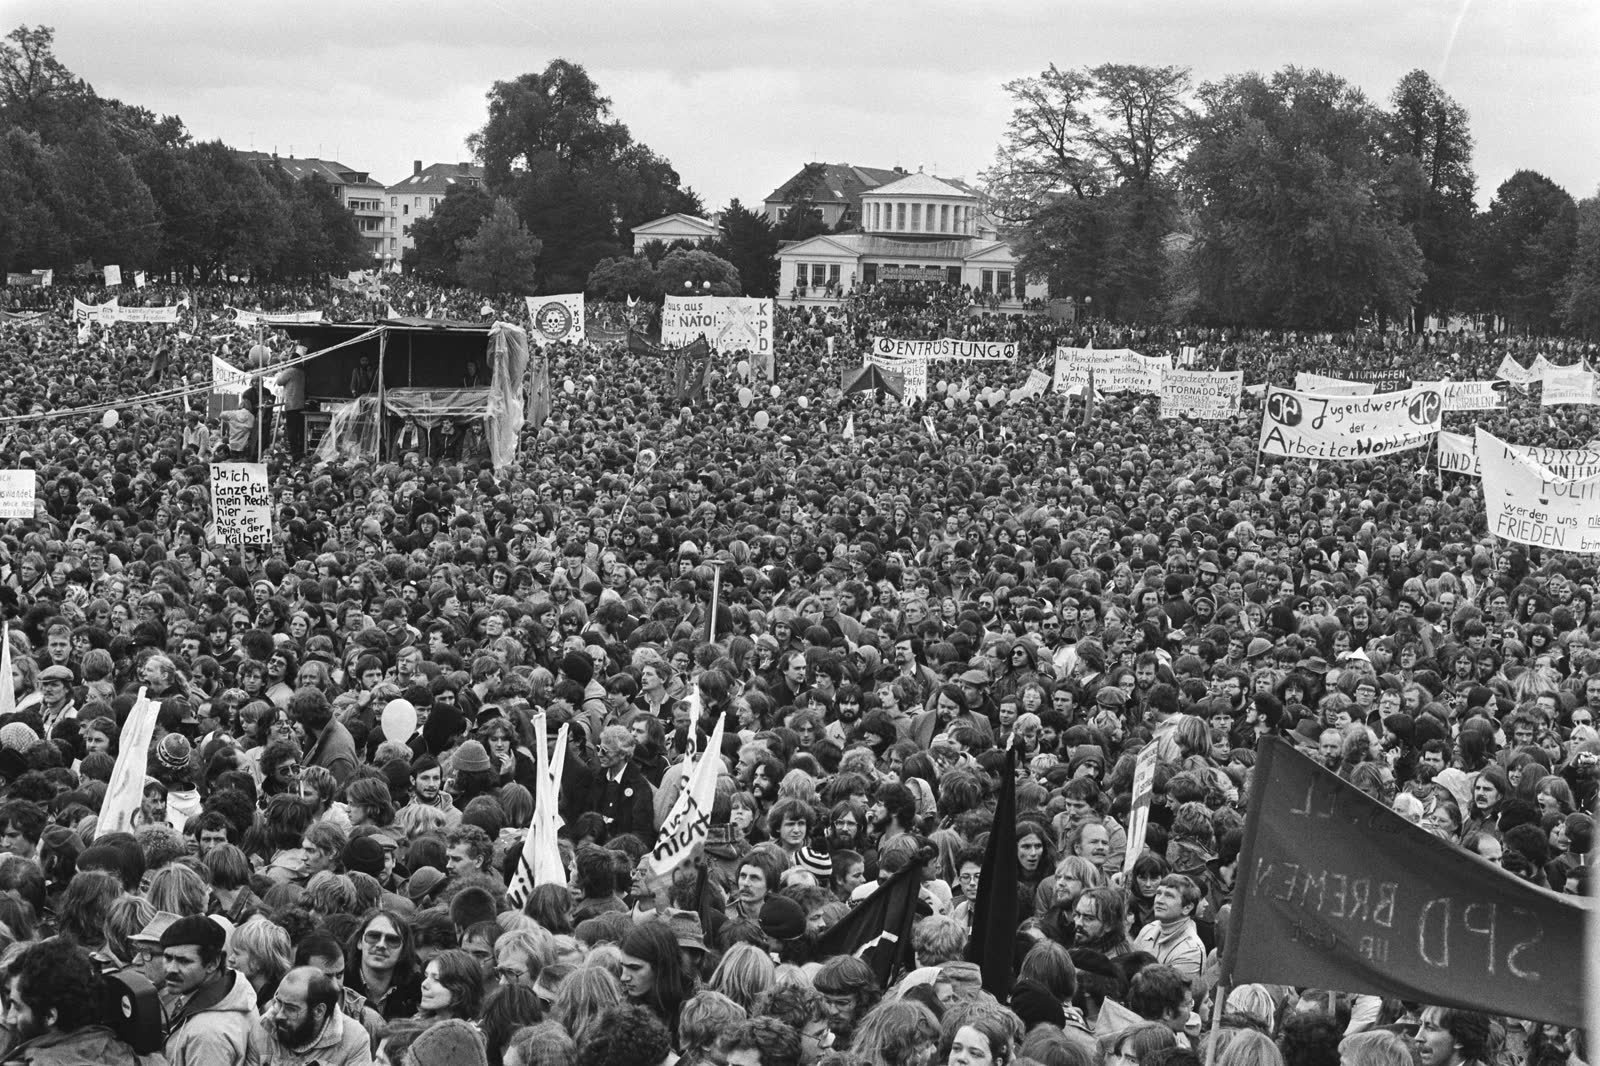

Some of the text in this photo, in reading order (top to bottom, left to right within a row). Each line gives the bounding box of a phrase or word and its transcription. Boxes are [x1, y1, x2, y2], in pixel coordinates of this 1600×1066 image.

[684, 302, 703, 312] aus
[679, 314, 717, 328] NATO!
[896, 337, 1000, 358] ENTRÜSTUNG
[1161, 369, 1229, 384] Jugendzentrum
[1315, 367, 1405, 380] KEINE ATOMWAFFEN
[1168, 385, 1216, 396] TORNADO
[1463, 383, 1482, 395] NOCH
[1308, 396, 1410, 430] Jugendwerk
[1350, 423, 1365, 434] der
[212, 465, 250, 482] Ja, ich
[214, 482, 266, 496] tanze für
[216, 494, 269, 507] mein Recht
[217, 505, 241, 517] hier
[216, 515, 258, 527] Aus der
[1556, 516, 1578, 526] uns
[217, 523, 265, 536] Reihe der
[225, 528, 271, 544] Kälber!
[1497, 513, 1566, 547] FRIEDEN
[652, 809, 710, 861] nicht
